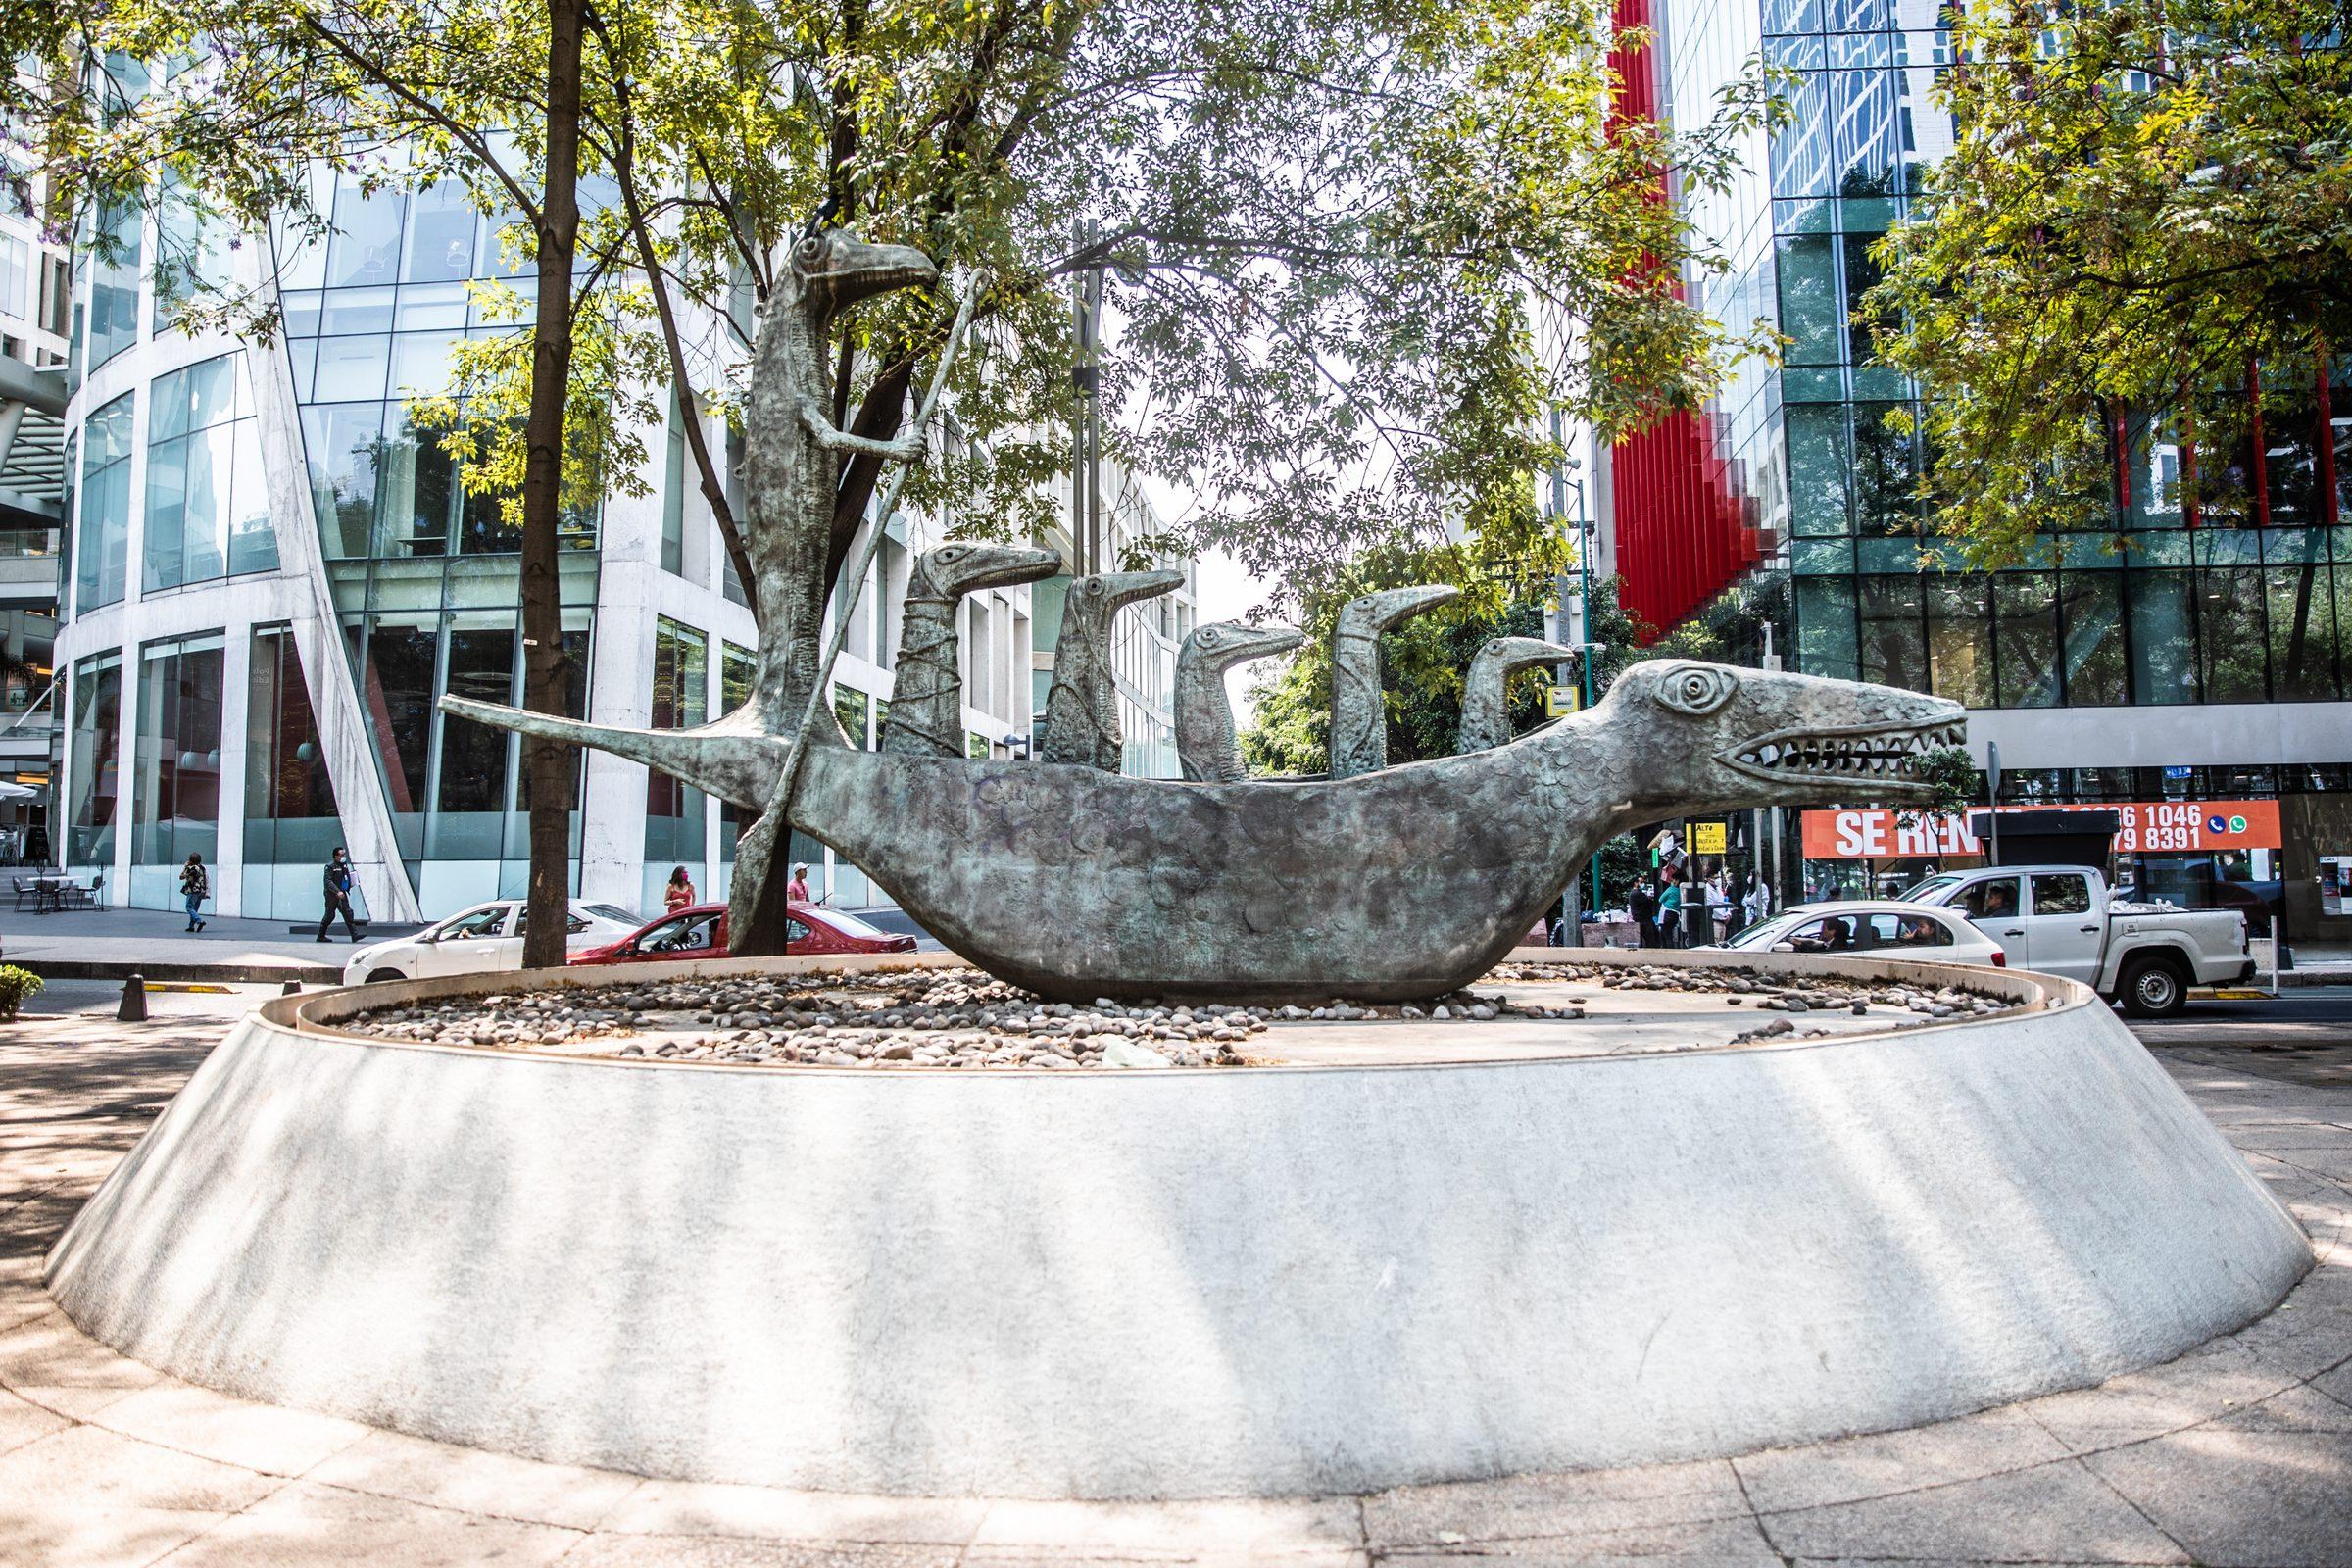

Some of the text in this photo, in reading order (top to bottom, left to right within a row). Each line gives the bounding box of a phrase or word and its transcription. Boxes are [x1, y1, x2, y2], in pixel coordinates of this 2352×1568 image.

[2145, 805, 2202, 827] 1046
[1836, 811, 1886, 856] SE
[1897, 808, 2021, 855] REN
[2145, 826, 2201, 850] 8391
